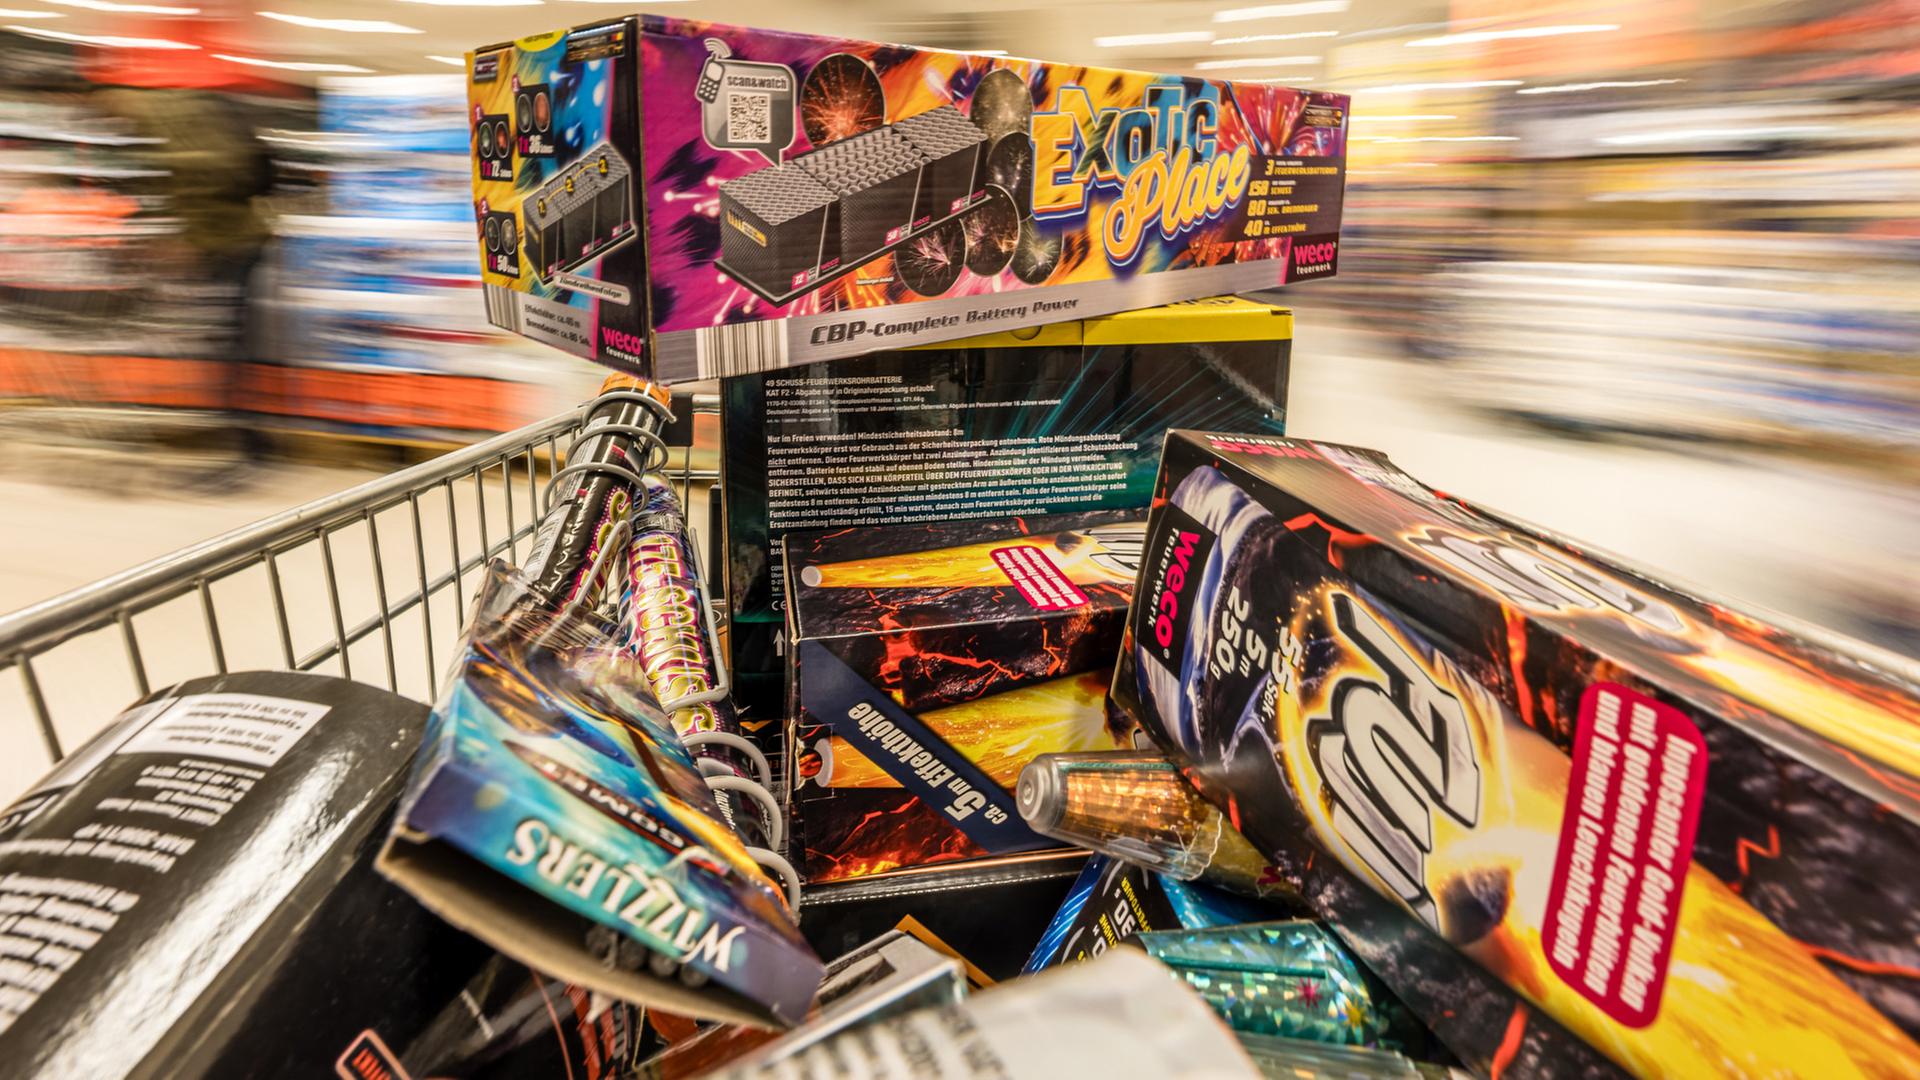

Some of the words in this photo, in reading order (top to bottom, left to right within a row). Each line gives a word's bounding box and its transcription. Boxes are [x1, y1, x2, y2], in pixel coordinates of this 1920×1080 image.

[727, 75, 787, 90] scan&watch
[1264, 159, 1274, 176] 3
[1103, 145, 1250, 265] Place
[1247, 200, 1266, 216] 80
[1244, 220, 1263, 236] 40
[1294, 242, 1334, 265] weco
[1296, 262, 1331, 275] feuerwerk
[810, 309, 960, 346] CBP-Complete
[966, 303, 1026, 325] Battery
[1031, 298, 1079, 315] Power
[602, 326, 642, 356] weco
[606, 346, 640, 365] feuerwerk
[776, 376, 903, 386] SCHUSS-FEUERWERKSROHRBATTERIE
[795, 388, 821, 397] Abgabe
[843, 385, 908, 396] Originalverpackung
[768, 445, 831, 456] Feuerwerkskörper
[833, 444, 847, 452] erst
[861, 442, 893, 451] Gebrauch
[909, 441, 919, 449] der
[921, 438, 997, 450] Sicherheitsverpackung
[1054, 433, 1121, 444] Mündungsabdeckung
[792, 434, 813, 442] Freien
[806, 466, 834, 474] Batterie
[836, 465, 849, 473] fest
[865, 464, 884, 472] stabil
[886, 463, 896, 471] auf
[898, 462, 922, 470] ebenen
[924, 461, 944, 469] Boden
[973, 458, 1011, 467] Hindernisse
[1013, 457, 1027, 465] über
[1028, 456, 1039, 464] der
[1041, 455, 1069, 465] Mündung
[825, 454, 847, 462] Dieser
[849, 452, 911, 462] Feuerwerkskörper
[925, 450, 940, 458] zwei
[990, 447, 1025, 457] Anzündung
[1027, 445, 1068, 454] identifizieren
[1083, 442, 1138, 453] Schutzabdeckung
[805, 486, 838, 495] seitwärts
[840, 485, 866, 494] stehend
[868, 483, 915, 492] Anzündschnur
[918, 482, 928, 490] mit
[930, 480, 971, 490] gestrecktem
[973, 479, 986, 487] Arm
[999, 477, 1031, 486] äußersten
[1033, 476, 1047, 484] Ende
[1049, 474, 1078, 483] anzünden
[1080, 474, 1091, 482] und
[1093, 473, 1106, 481] sich
[1107, 472, 1127, 480] sofort
[828, 476, 846, 484] DASS
[848, 475, 864, 483] SICH
[866, 474, 881, 482] KEIN
[883, 470, 923, 481] KÖRPERTEIL
[925, 469, 943, 479] ÜBER
[945, 470, 958, 478] DEM
[960, 465, 1030, 477] FEUERWERKSKÖRPER
[1032, 466, 1049, 474] ODER
[1073, 462, 1123, 472] WIRKRICHTUNG
[769, 499, 808, 508] mindestens
[861, 494, 896, 503] Zuschauer
[898, 493, 923, 501] müssen
[925, 491, 962, 500] mindestens
[978, 488, 1004, 497] entfernt
[1022, 487, 1037, 495] Falls
[1039, 486, 1049, 494] der
[1051, 483, 1108, 494] Feuerwerkskörper
[1110, 482, 1127, 490] seine
[770, 509, 799, 518] Funktion
[801, 508, 818, 516] nicht
[820, 506, 857, 517] vollständig
[935, 501, 959, 509] danach
[975, 497, 1034, 508] Feuerwerkskörper
[1036, 494, 1078, 504] zurückkehren
[1092, 493, 1103, 501] die
[1148, 528, 1180, 627] feuerwerk
[1156, 531, 1200, 648] weco
[1594, 689, 1622, 742] und
[1628, 702, 1658, 750] mit
[848, 702, 955, 788] Effekthöhe
[1580, 735, 1618, 820] blauen
[541, 761, 685, 849] COMET
[1610, 742, 1652, 859] goldenen
[984, 803, 1008, 825] ca.
[506, 819, 746, 973] WIZZLERS
[1552, 814, 1605, 970] Leuchtkugeln
[1583, 852, 1636, 997] Feuerblüten
[1619, 864, 1675, 1012] Gold-Vulkan
